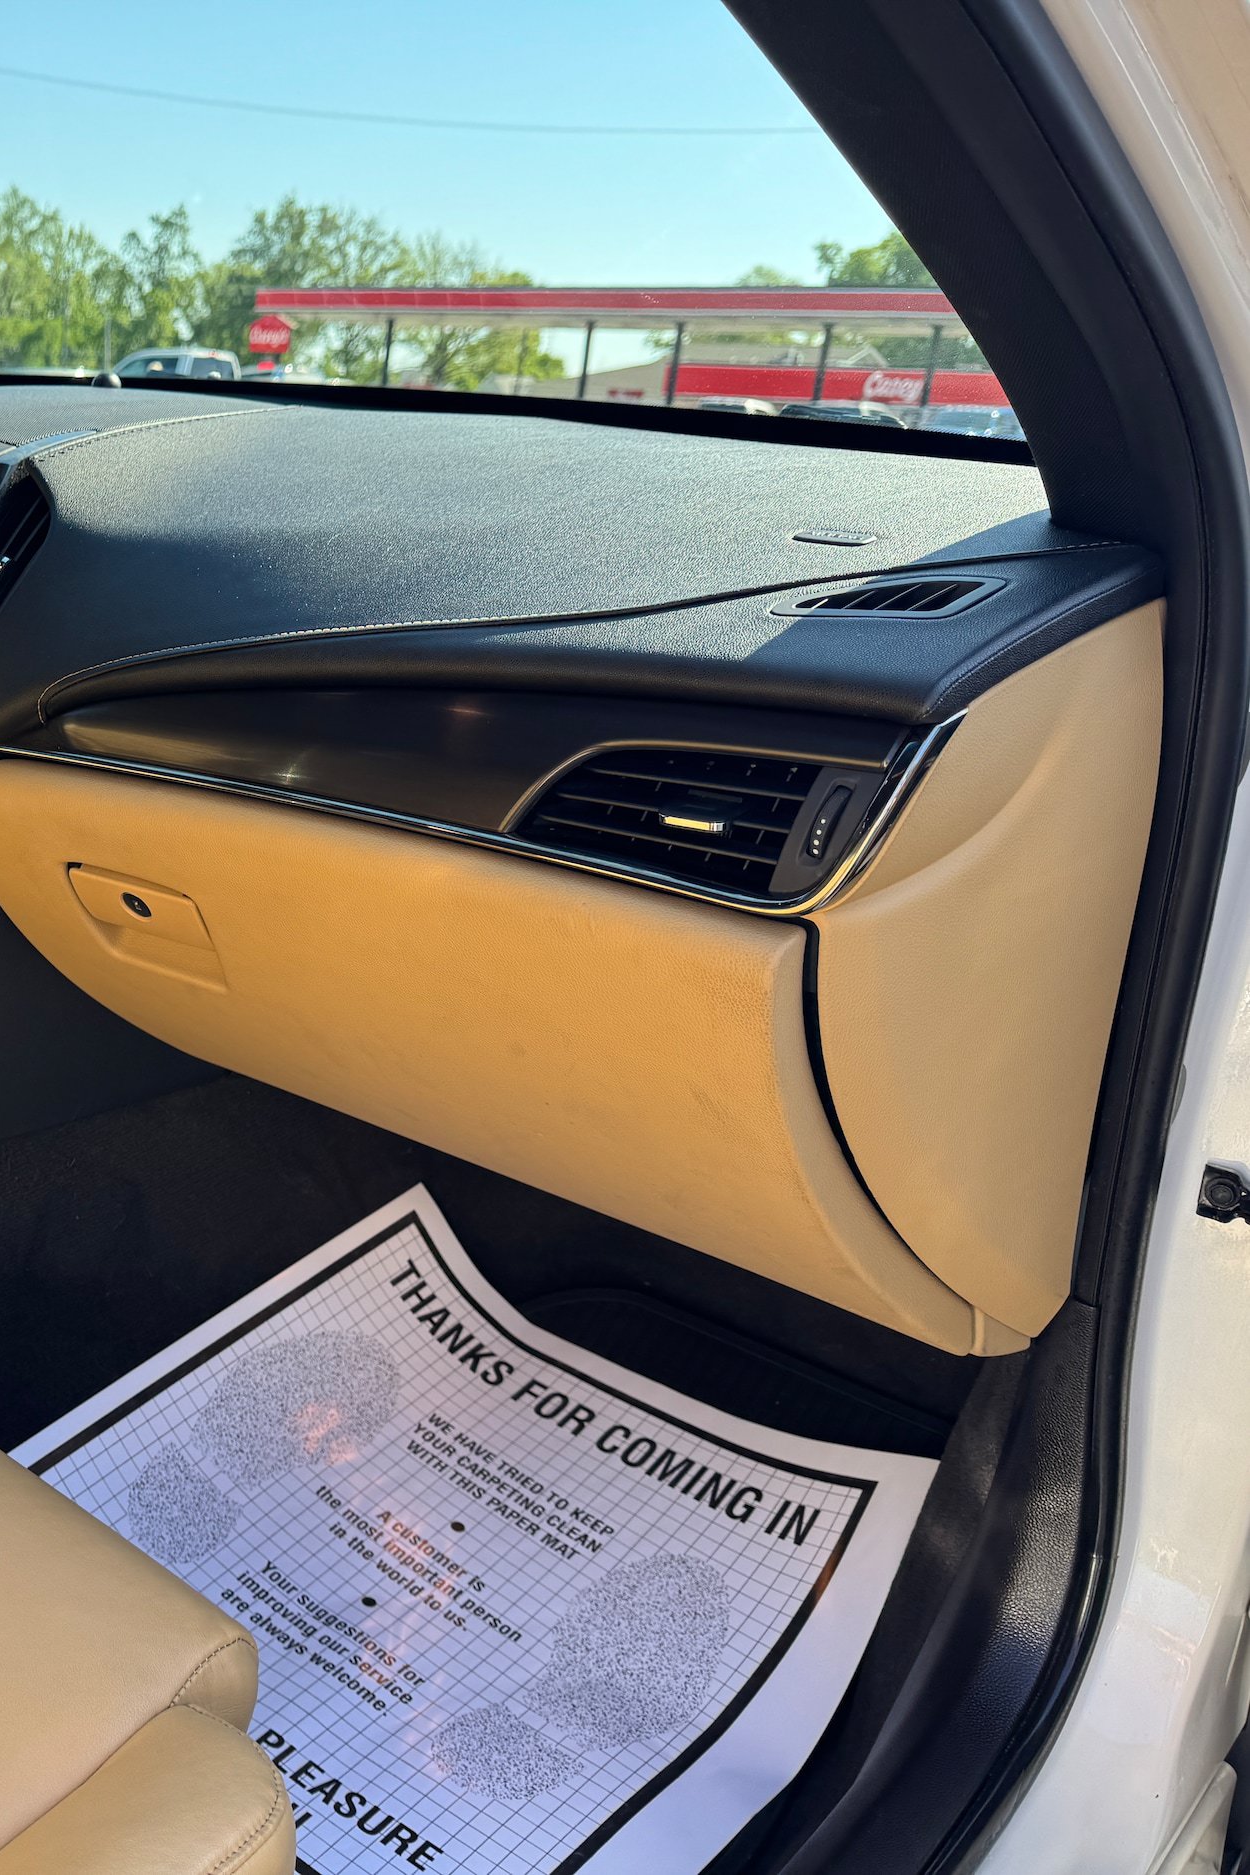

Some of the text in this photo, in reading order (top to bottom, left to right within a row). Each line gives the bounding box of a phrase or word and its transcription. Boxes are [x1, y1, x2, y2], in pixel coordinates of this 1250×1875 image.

[391, 1259, 820, 1546] THANKS FOR COMING IN
[407, 1440, 581, 1561] WITH THIS PAPER MAT
[414, 1423, 602, 1553] YOUR CARPETING CLEAN
[429, 1413, 615, 1537] WE HAVE TRIED TO KEEP
[316, 1485, 523, 1643] the most important person
[329, 1521, 468, 1631] in the world to us.
[377, 1510, 485, 1592] A customer is
[221, 1588, 388, 1716] are always welcome.
[237, 1570, 413, 1704] improving our service
[260, 1560, 426, 1687] Your suggestions for
[256, 1729, 444, 1872] PLEASURE
